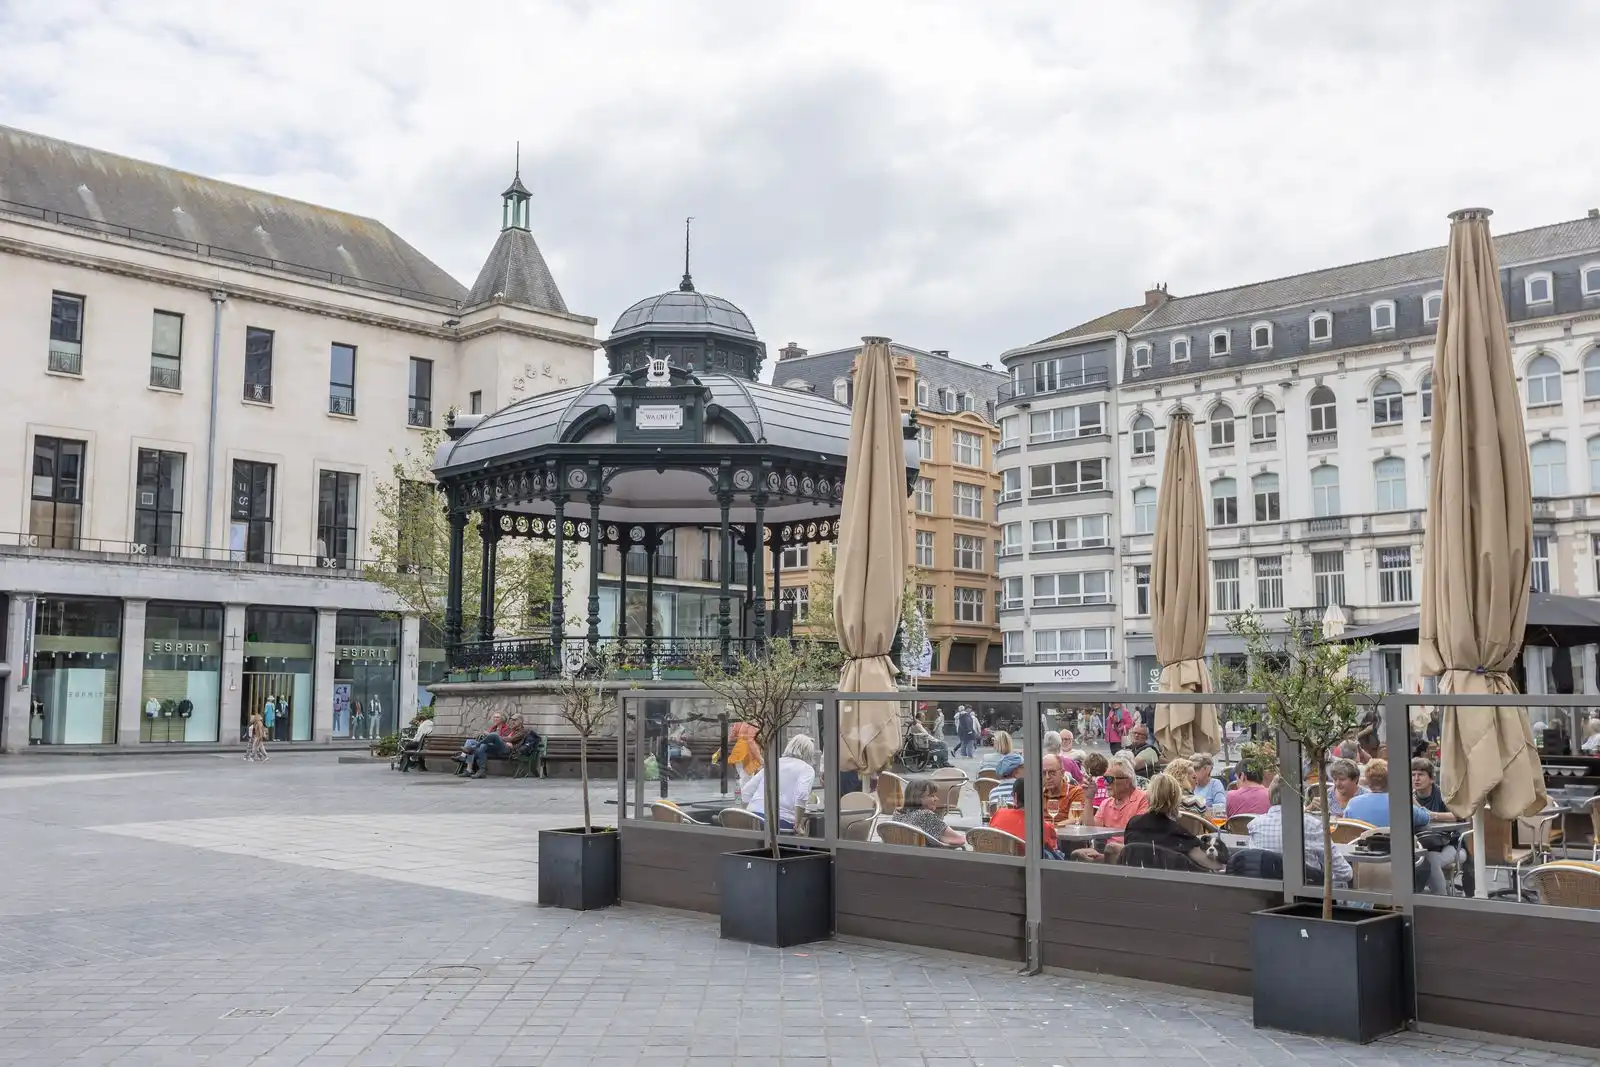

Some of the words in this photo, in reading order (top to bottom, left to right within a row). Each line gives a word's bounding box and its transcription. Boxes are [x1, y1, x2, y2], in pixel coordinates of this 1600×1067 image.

[645, 413, 675, 421] WAGNER
[153, 641, 209, 653] ESPRIT
[341, 647, 390, 658] ESPRIT
[1054, 668, 1080, 677] KIKO
